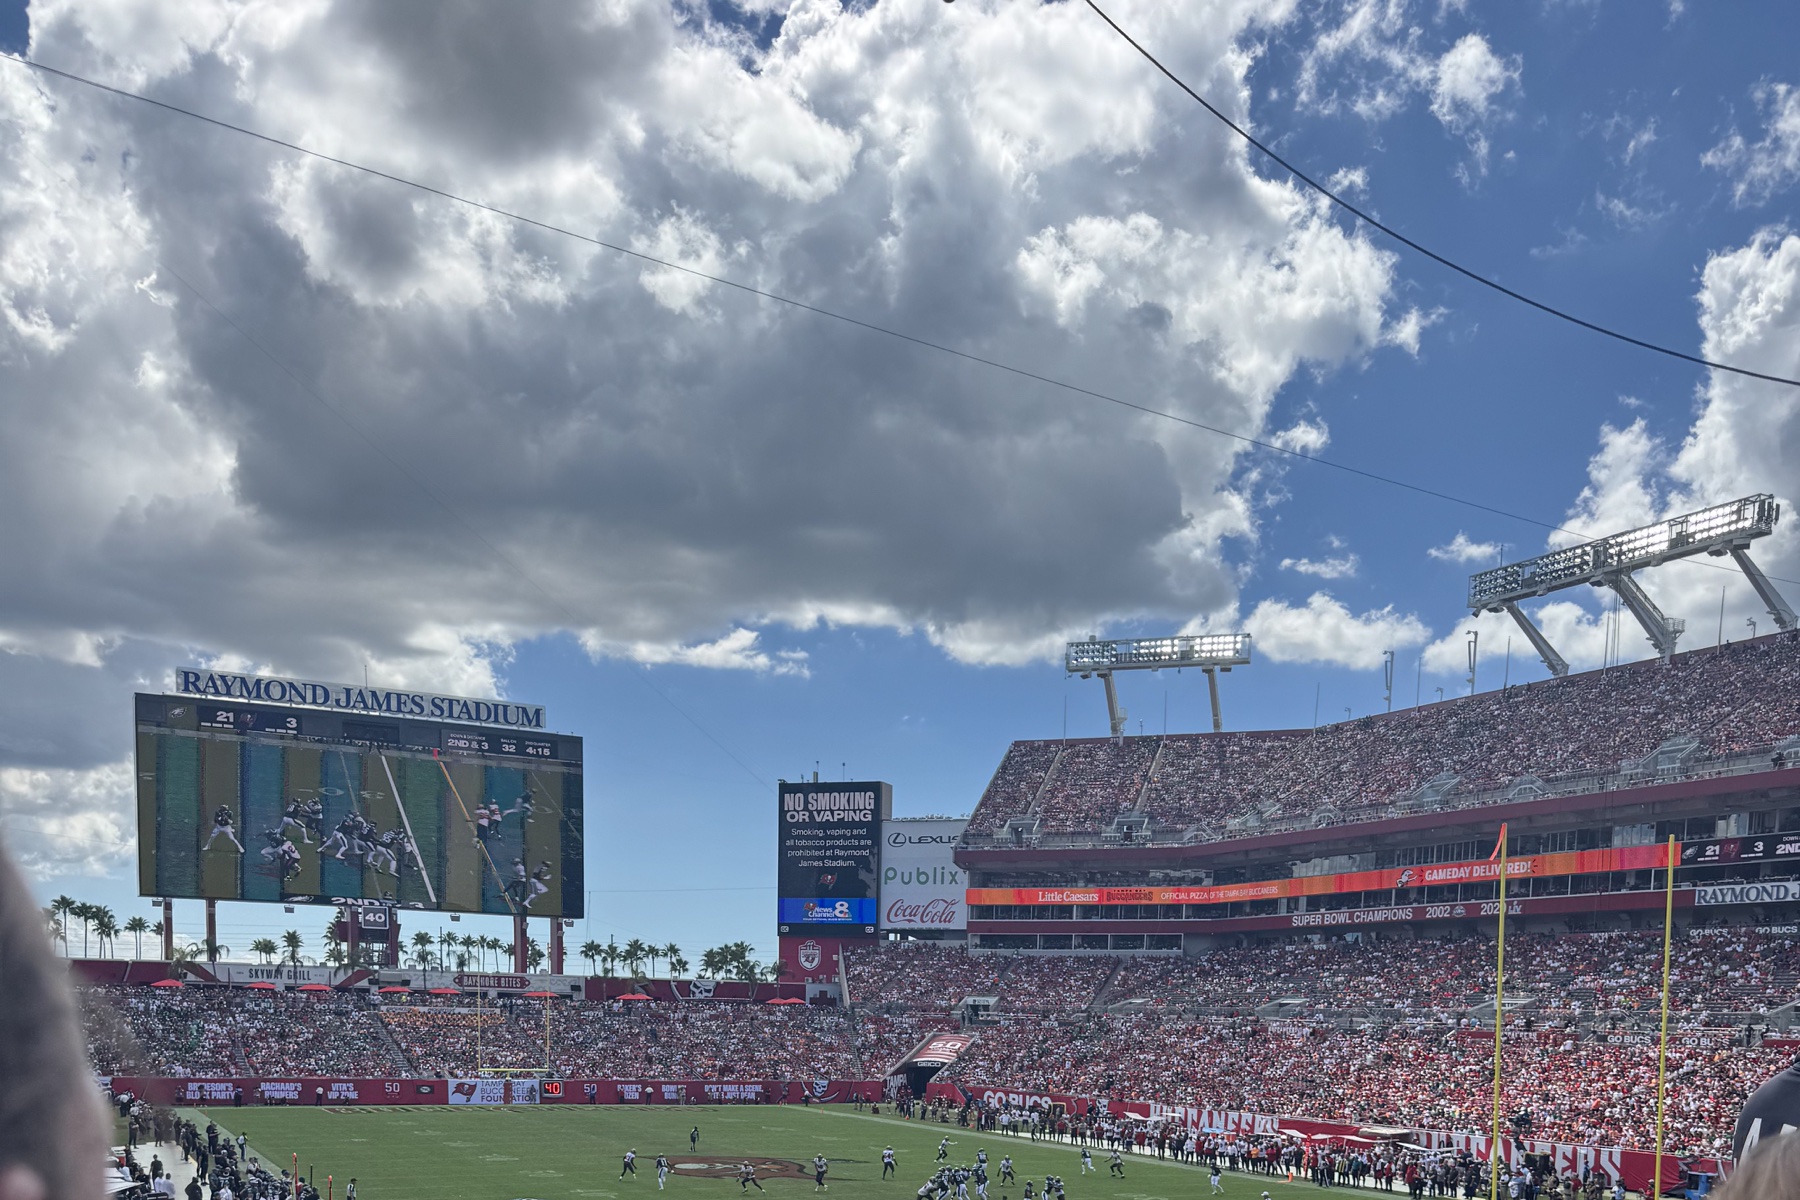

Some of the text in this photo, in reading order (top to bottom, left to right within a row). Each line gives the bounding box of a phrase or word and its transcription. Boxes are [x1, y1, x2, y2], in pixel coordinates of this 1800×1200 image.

[181, 670, 543, 728] RAYMOND JAMES STADIUM
[216, 711, 234, 723] 21
[286, 717, 298, 728] 3
[447, 739, 489, 750] 2ND & 3
[501, 744, 516, 752] 32
[526, 747, 551, 756] 4:15
[784, 791, 875, 811] NO SMOKING
[786, 810, 872, 822] OR VAPING
[791, 828, 825, 836] Smoking,
[826, 839, 859, 847] products
[1753, 841, 1764, 852] 3
[787, 849, 825, 857] prohibited
[834, 849, 870, 857] Raymond
[1705, 845, 1720, 856] 21
[823, 859, 856, 867] Stadium.
[884, 866, 959, 886] Publix
[1425, 866, 1471, 881] GAMEDAY
[1038, 891, 1099, 902] Little Caesars
[1106, 891, 1153, 902] BUCCANEERS
[1160, 892, 1189, 900] OFFICIAL
[1248, 886, 1278, 896] BUCCANEERS
[1696, 885, 1789, 904] RAYMOND
[834, 901, 849, 918] 8
[1425, 906, 1450, 919] 2002
[1480, 902, 1506, 916] 202
[364, 913, 386, 923] 40
[1292, 908, 1413, 926] SUPER BOWL CHAMPIONS
[1756, 925, 1798, 934] GO BUCS
[248, 968, 312, 980] SKYWAY GRILL
[500, 977, 521, 988] BITES
[1607, 1034, 1651, 1044] GO BUCS
[1682, 1037, 1698, 1046] GO
[886, 1073, 908, 1085] TAMPA
[260, 1082, 302, 1091] RACHAAD'S
[331, 1082, 354, 1092] VITA'S
[384, 1082, 400, 1093] 50
[545, 1082, 560, 1094] 40
[722, 1084, 738, 1092] MAKE
[186, 1091, 236, 1100] BLOK PARTY
[327, 1091, 340, 1099] VIP
[983, 1090, 1006, 1108] GO
